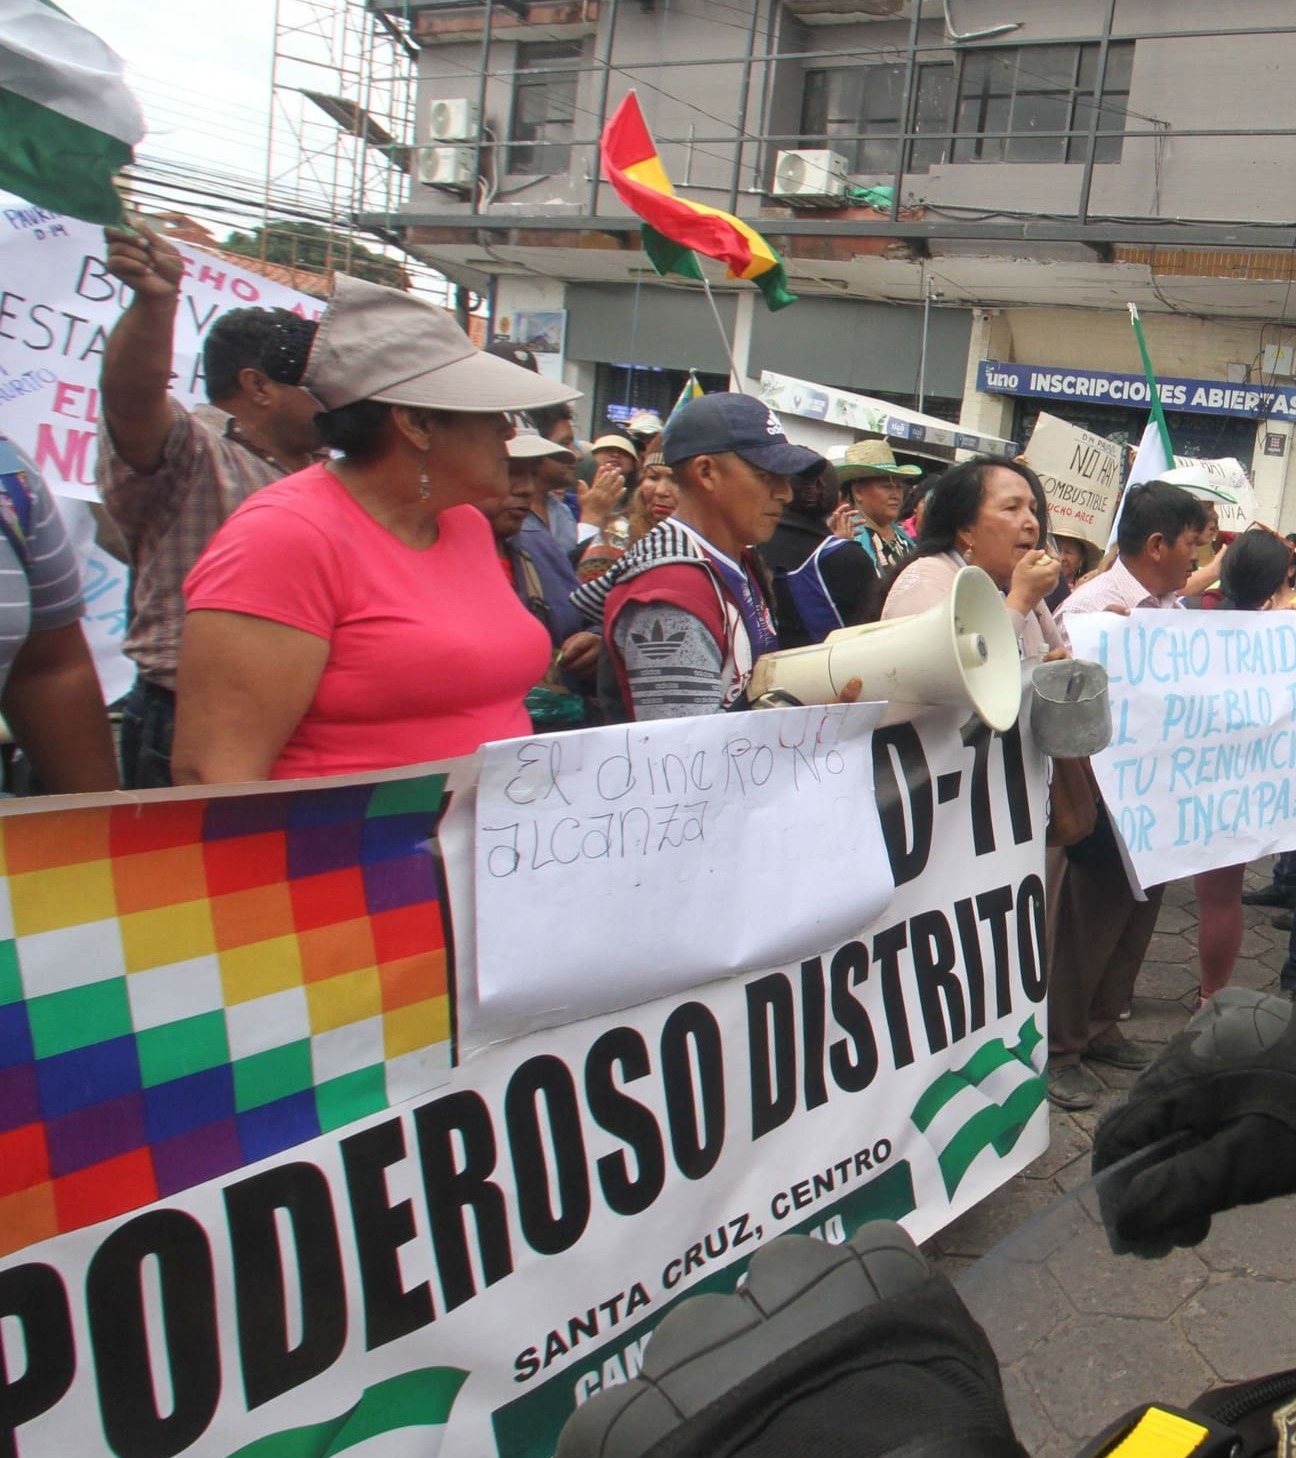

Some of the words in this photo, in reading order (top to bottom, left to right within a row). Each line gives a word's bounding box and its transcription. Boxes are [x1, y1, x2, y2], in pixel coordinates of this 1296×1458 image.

[986, 371, 1018, 388] uno
[1030, 373, 1186, 405] INSCRIPCIONES
[1069, 444, 1101, 477] NO
[1096, 455, 1118, 487] HAY
[1046, 502, 1072, 517] UCHO
[1100, 623, 1210, 686] LUCHO
[1163, 687, 1272, 742] PUEBLO
[871, 712, 1033, 888] D-11
[1112, 756, 1158, 800] TU
[1118, 804, 1156, 853] OR
[0, 1001, 726, 1458] PODEROSO
[745, 873, 1049, 1141] DISTRITO
[513, 1282, 652, 1383] SANTA
[662, 1213, 764, 1290] CRUZ,
[771, 1138, 892, 1220] CENTRO
